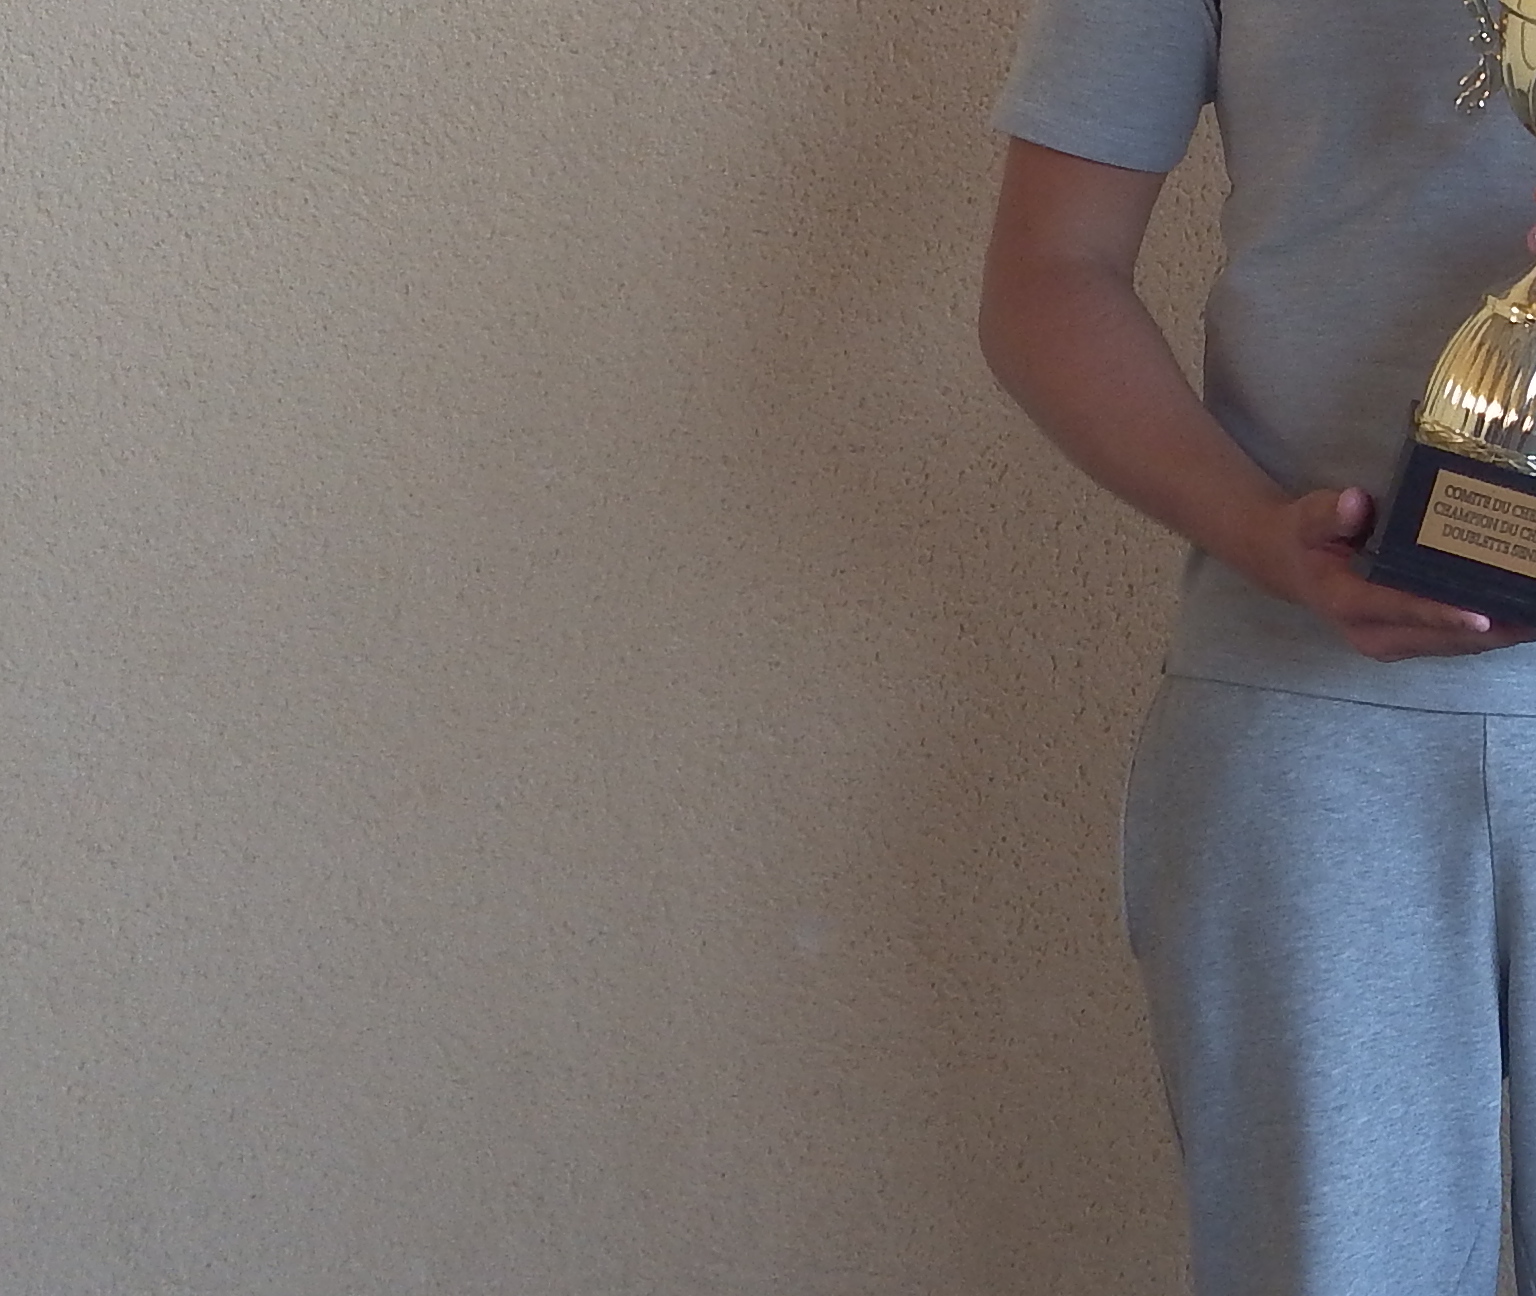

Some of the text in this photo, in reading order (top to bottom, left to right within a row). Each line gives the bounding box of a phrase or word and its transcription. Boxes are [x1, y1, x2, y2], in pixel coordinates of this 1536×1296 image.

[1434, 501, 1499, 532] CHAMPION
[1499, 520, 1519, 536] DU
[1492, 498, 1511, 514] DU
[1442, 523, 1511, 554] DOUBLETTE
